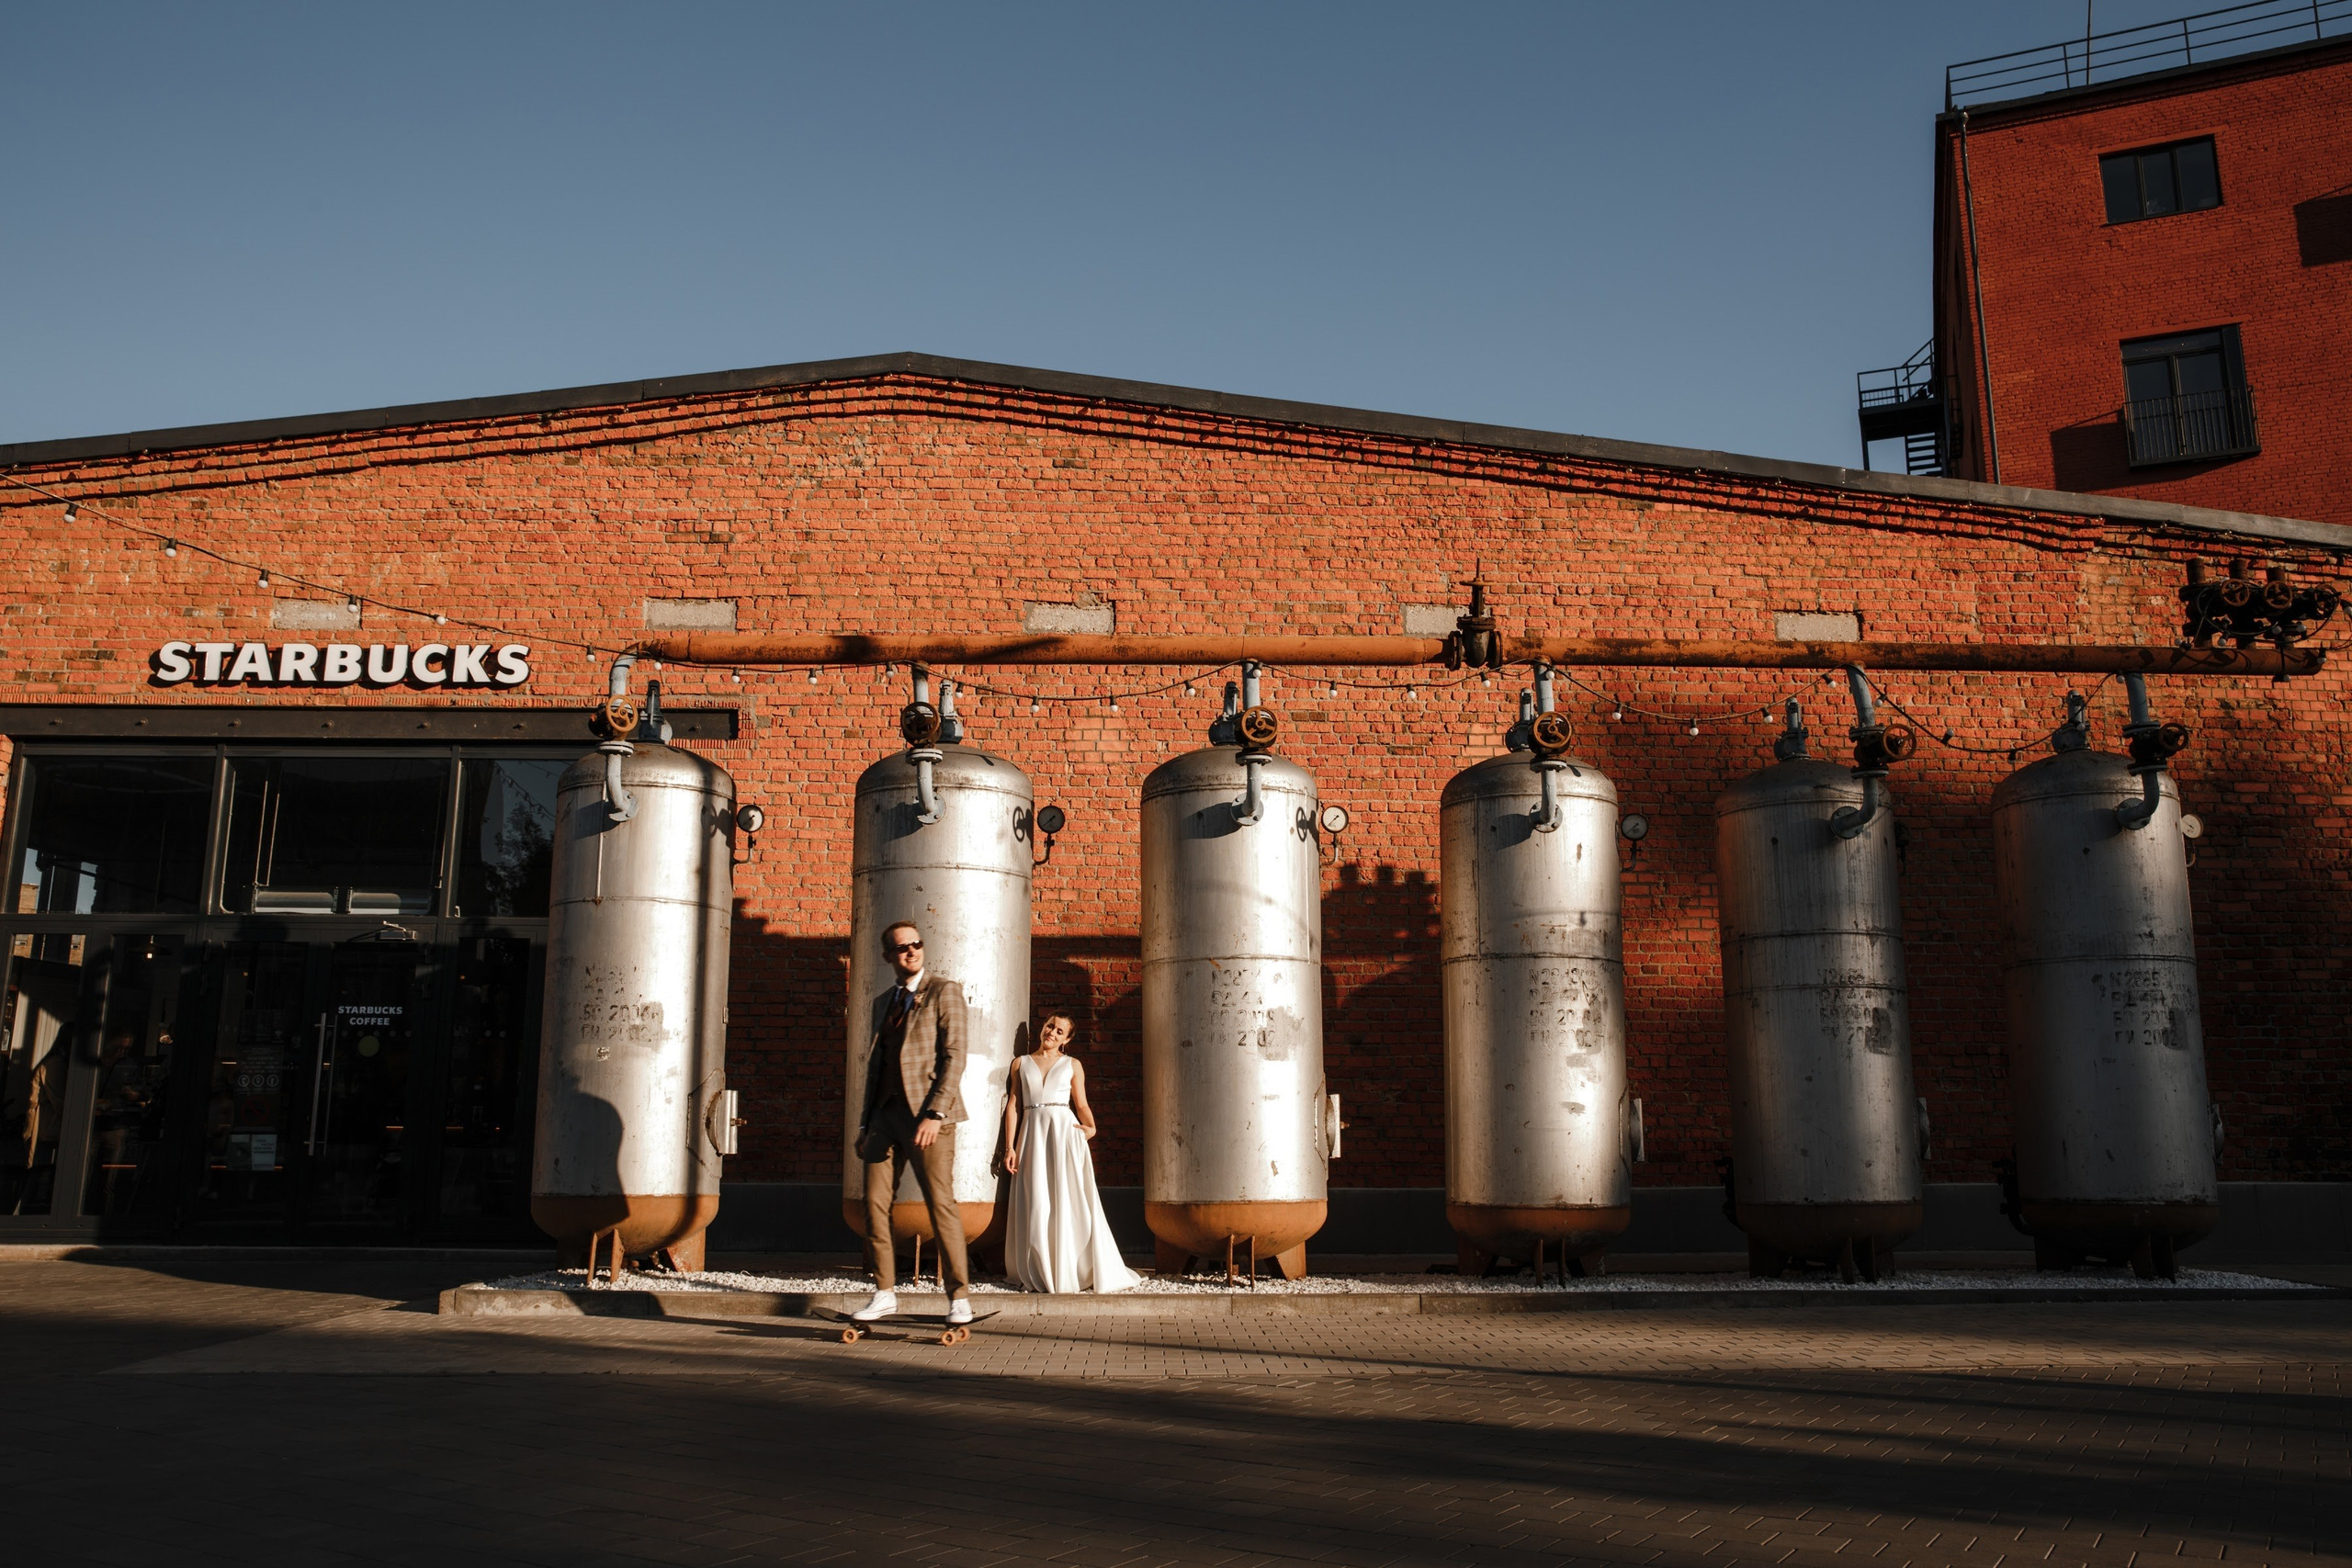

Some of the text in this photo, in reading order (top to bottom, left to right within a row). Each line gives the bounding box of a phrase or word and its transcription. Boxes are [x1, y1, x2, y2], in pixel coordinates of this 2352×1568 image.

[155, 640, 530, 687] STARBUCKS
[338, 1005, 403, 1015] STARBUCKS
[349, 1017, 390, 1026] COFFEE
